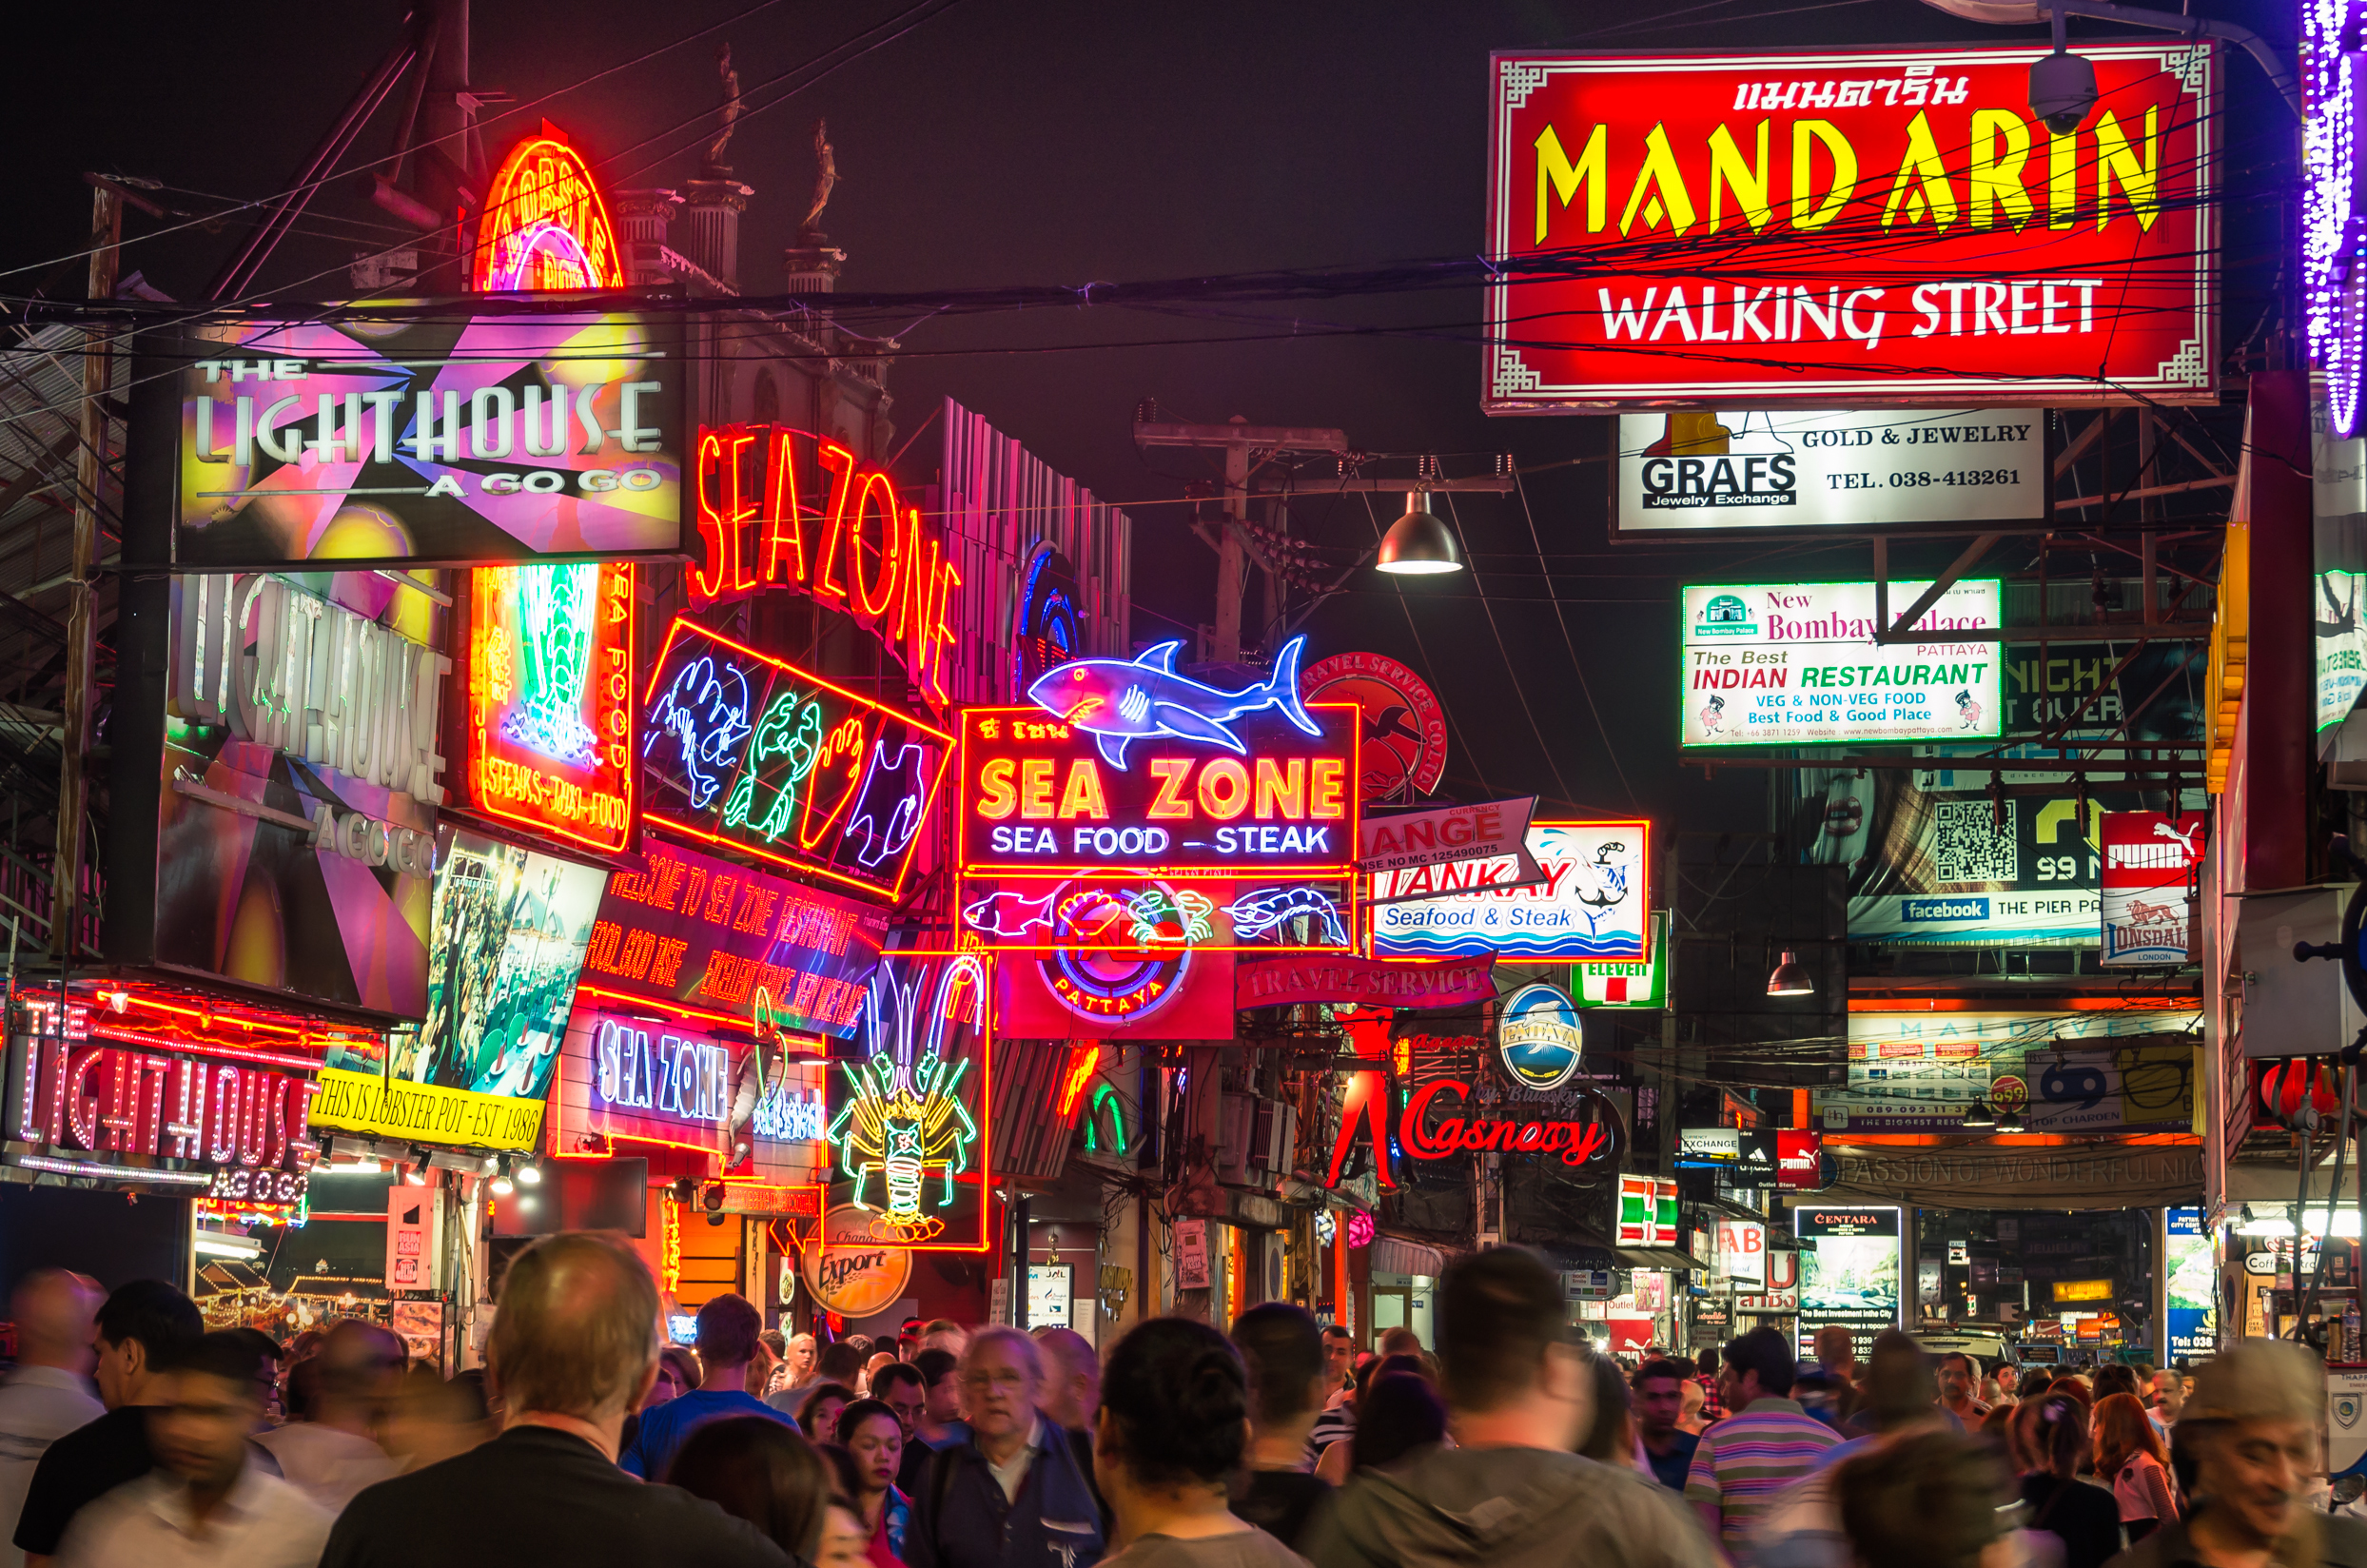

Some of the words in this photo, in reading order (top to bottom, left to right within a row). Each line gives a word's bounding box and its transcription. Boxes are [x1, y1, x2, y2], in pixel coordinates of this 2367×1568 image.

[1533, 102, 2162, 246] MANDARIN
[1598, 285, 1886, 348] WALKING
[1911, 278, 2103, 337] STREET
[194, 359, 309, 382] THE
[194, 381, 662, 466] LIGHTHOUSE
[1803, 430, 1873, 447] GOLD
[1881, 428, 1900, 444] &
[1906, 424, 2031, 445] JEWELRY
[427, 476, 467, 498] A
[480, 470, 565, 494] GO
[577, 468, 662, 492] GO
[1641, 454, 1796, 495] GRAFS
[1827, 473, 1885, 489] TEL.
[1889, 469, 2021, 489] 038-413261
[1652, 494, 1709, 508] Jewelry
[1715, 492, 1790, 506] Exchange
[691, 424, 806, 609] SEA
[816, 440, 962, 710] ZONE
[1767, 592, 1813, 609] New
[1712, 627, 1734, 636] Bombay
[1768, 612, 1878, 645] Bombay
[1693, 651, 1731, 665] The
[1741, 650, 1789, 664] Best
[1917, 644, 1987, 656] PATTAYA
[1300, 655, 1365, 693] RAVEL
[1369, 656, 1434, 714] SERVICE
[1692, 668, 1788, 690] INDIAN
[1801, 663, 1988, 688] RESTAURANT
[607, 647, 628, 770] FOOD
[1756, 696, 1786, 707] VEG
[1792, 695, 1803, 707] &
[1809, 694, 1878, 706] NON-VEG
[1885, 693, 1927, 705] FOOD
[2032, 696, 2122, 724] OVER
[1749, 712, 1780, 724] Best
[1786, 710, 1823, 723] Food
[1829, 711, 1840, 722] &
[1847, 709, 1887, 722] Good
[1893, 709, 1932, 721] Place
[1731, 729, 1744, 737] Tel:
[1781, 728, 1801, 736] 1259
[1807, 728, 1836, 736] Website
[1844, 726, 1953, 737] www.newbombaypattaya.com
[977, 757, 1110, 820] SEA
[1146, 757, 1345, 821] ZONE
[1449, 804, 1500, 815] CURRENCY
[306, 803, 337, 850] A
[336, 813, 388, 867] GO
[387, 825, 437, 880] GO
[990, 826, 1059, 855] SEA
[1074, 826, 1170, 855] FOOD
[1215, 826, 1330, 855] STEAK
[1388, 857, 1406, 868] NO
[1409, 854, 1428, 865] MC
[1432, 844, 1498, 862] 125490075
[2108, 843, 2182, 870] PUMA
[681, 866, 707, 917] TO
[704, 873, 748, 927] SEA
[733, 881, 779, 938] ZONE
[773, 895, 859, 957] RESTAURANT
[1385, 907, 1475, 927] Seafood
[1484, 907, 1502, 926] &
[1509, 907, 1573, 927] Steak
[1908, 899, 1983, 919] facebook
[1999, 900, 2028, 915] THE
[2035, 899, 2072, 914] PIER
[2107, 922, 2188, 960] LONSDAL
[1245, 967, 1360, 997] TRAVEL
[1367, 966, 1484, 996] SERVICE
[1054, 978, 1164, 1013] PATTAYA
[26, 999, 88, 1041] THE
[1901, 1018, 2155, 1038] MALDIVES
[1502, 1025, 1580, 1052] PATTAYA
[597, 1019, 653, 1109] SEA
[659, 1034, 729, 1123] ZONE
[13, 1036, 323, 1169] LIGHTHOUSE
[1994, 1087, 2024, 1104] 999
[316, 1076, 353, 1119] THIS
[352, 1084, 371, 1121] IS
[369, 1087, 437, 1129] LOBSTER
[438, 1096, 466, 1134] POT
[502, 1106, 539, 1143] 1986
[2035, 1118, 2058, 1127] TOP
[2063, 1111, 2120, 1126] CHAROEN
[1861, 1118, 1880, 1127] THE
[1885, 1118, 1932, 1127] BIGGEST
[1683, 1140, 1737, 1148] EXCHANGE
[1780, 1158, 1810, 1170] PUMA
[1842, 1157, 1950, 1184] PASSION
[1959, 1156, 1986, 1182] OF
[1986, 1156, 2150, 1184] WONDERFUL
[1814, 1213, 1877, 1225] CENTARA
[398, 1243, 420, 1253] ASIA
[399, 1232, 421, 1244] RUN
[819, 1250, 887, 1291] Export
[1608, 1300, 1634, 1309] Outlet
[1801, 1309, 1812, 1318] The
[1813, 1309, 1828, 1318] Best
[1829, 1309, 1863, 1318] Investment
[1879, 1309, 1892, 1320] City
[2171, 1336, 2191, 1347] Tel:
[2192, 1336, 2213, 1347] 038
